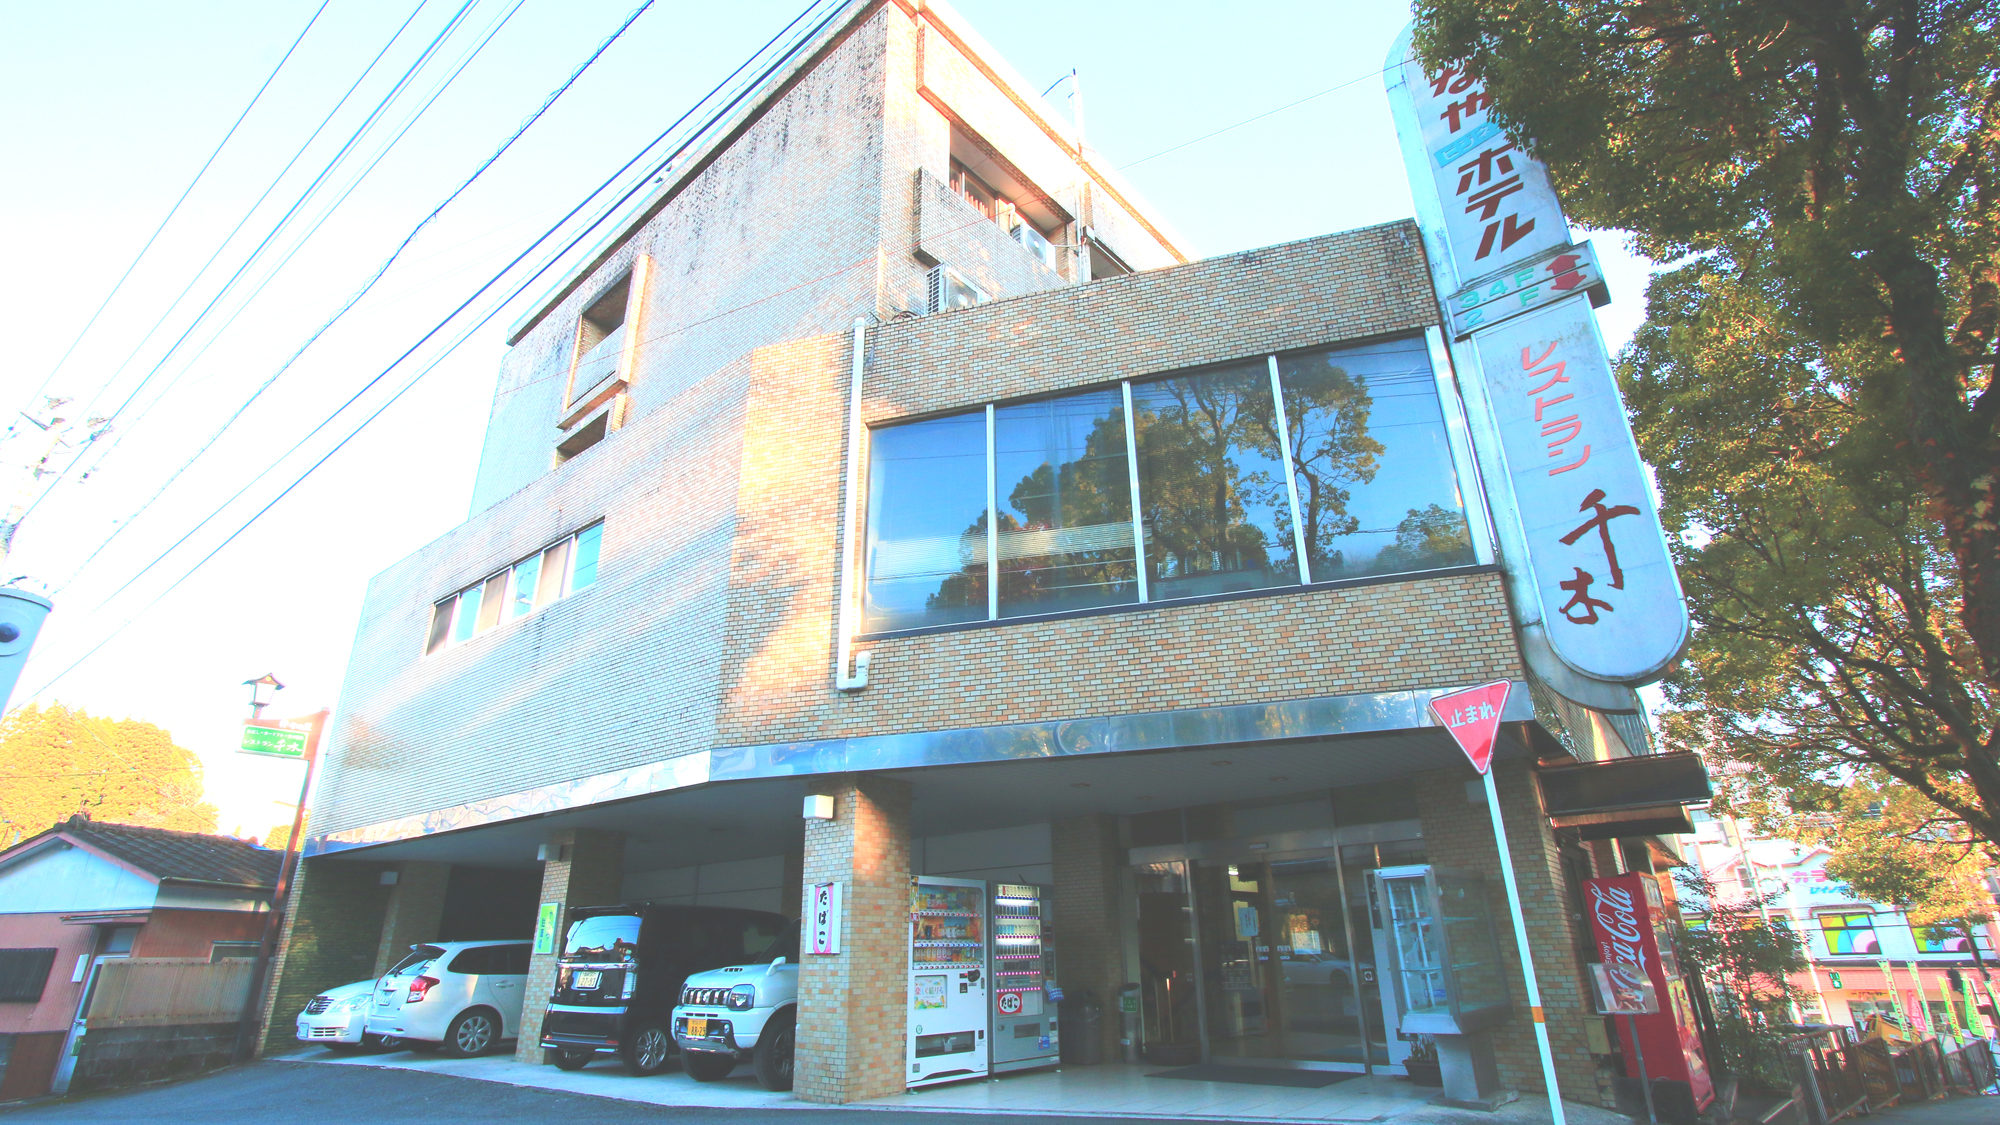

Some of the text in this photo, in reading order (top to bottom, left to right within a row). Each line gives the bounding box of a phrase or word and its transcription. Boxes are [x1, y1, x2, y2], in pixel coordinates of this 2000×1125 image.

[1441, 124, 1496, 160] ビジネ
[1455, 143, 1536, 261] ホテル
[1522, 341, 1591, 477] レストラン
[1450, 701, 1496, 728] 止まれ
[818, 890, 829, 945] たばこ
[1589, 880, 1645, 1003] Coca-Cola
[1001, 996, 1019, 1010] たばこ
